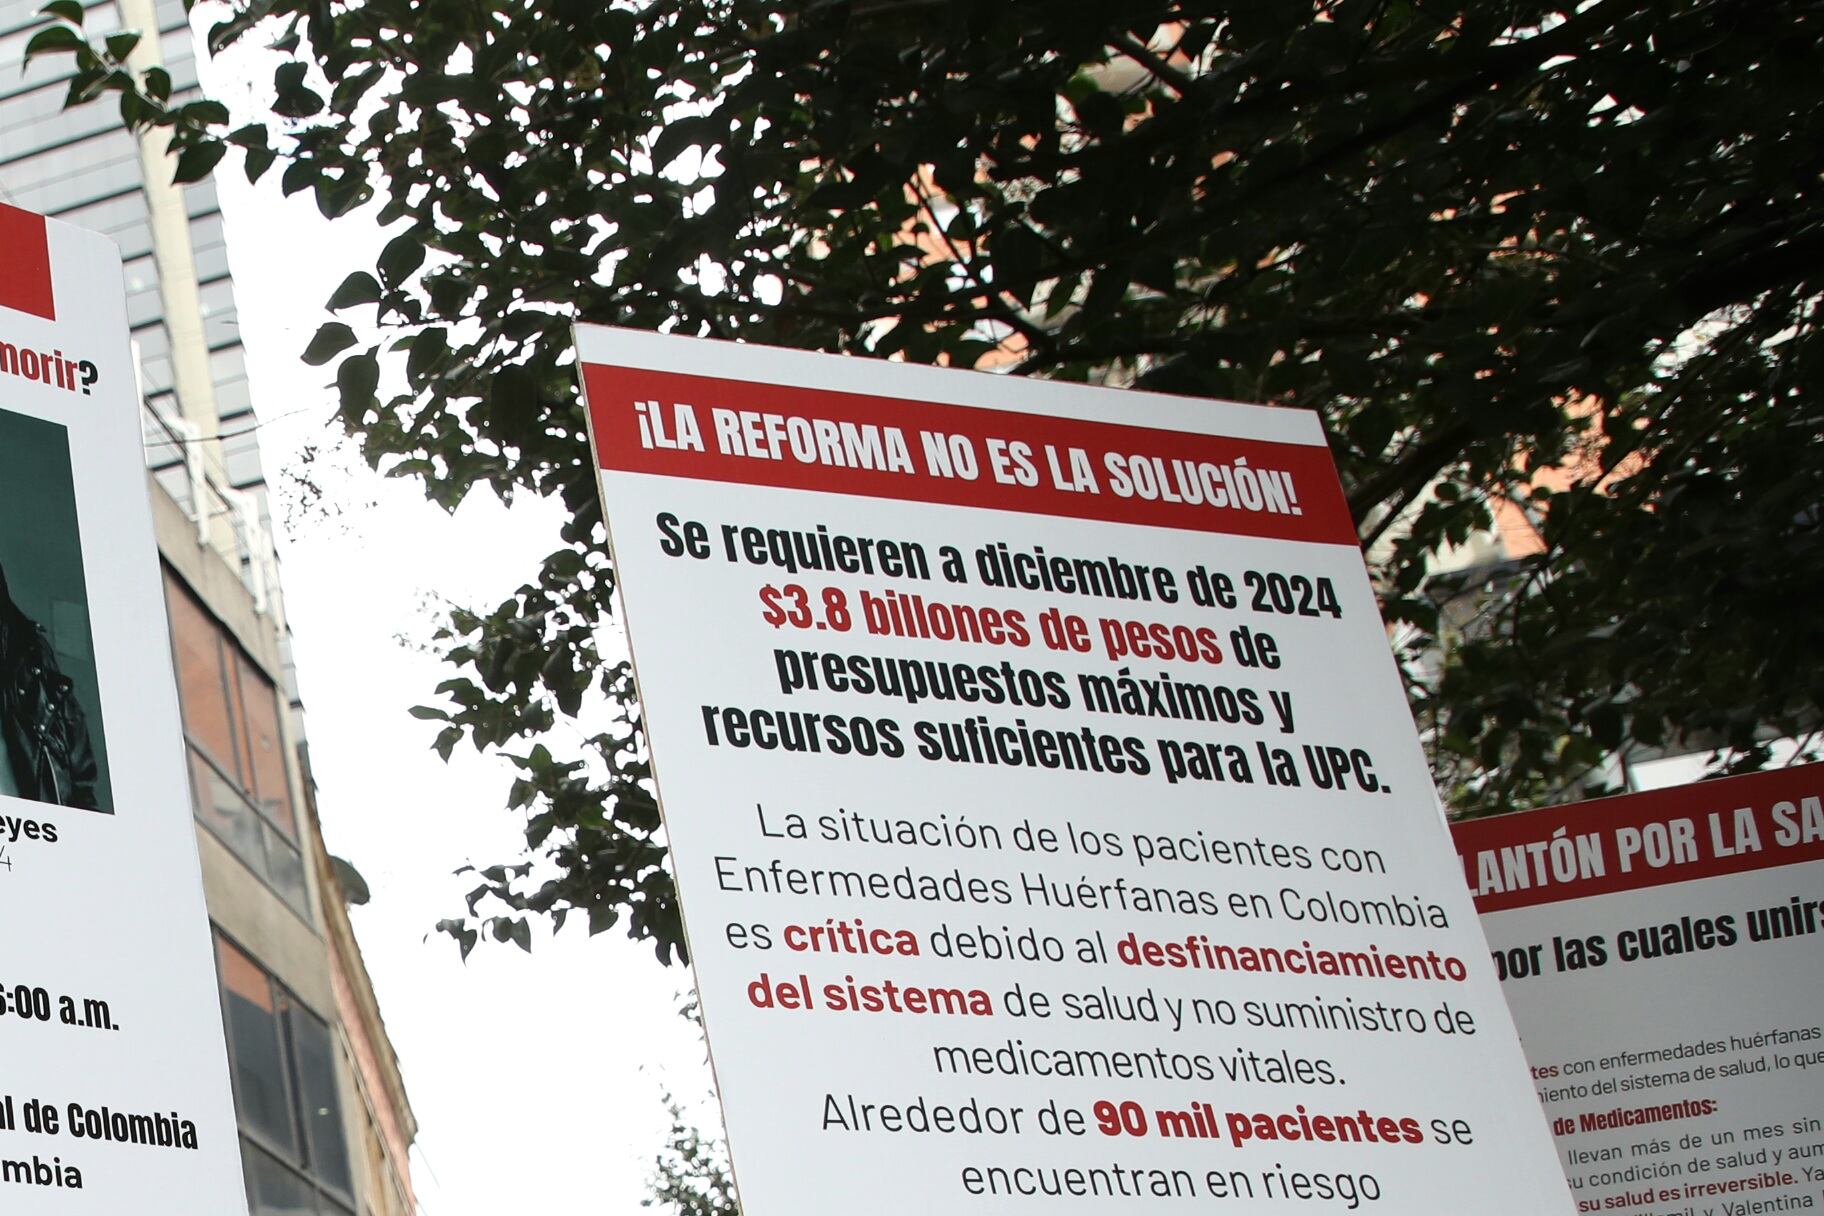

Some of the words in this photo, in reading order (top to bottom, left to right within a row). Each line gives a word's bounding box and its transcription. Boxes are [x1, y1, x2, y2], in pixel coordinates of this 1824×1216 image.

[634, 400, 706, 453] ¡LA
[711, 407, 916, 475] REFORMA
[919, 430, 979, 481] NO
[985, 437, 1039, 487] ES
[1044, 444, 1100, 494] LA
[1103, 451, 1303, 516] SOLUCIÓN!
[656, 511, 711, 560] Se
[720, 524, 931, 581] requieren
[938, 545, 968, 584] a
[975, 541, 1179, 604] diciembre
[1185, 564, 1238, 610] de
[1243, 570, 1343, 620] 2024
[758, 583, 852, 633] $3.8
[859, 589, 1031, 648] billones
[1038, 607, 1092, 653] de
[1098, 617, 1224, 665] pesos
[1229, 624, 1282, 670] de
[773, 648, 1071, 710] presupuestos
[1077, 666, 1265, 726] máximos
[1268, 690, 1295, 734] y
[701, 705, 905, 759] recursos
[913, 715, 1151, 776] suficientes
[1156, 739, 1255, 785] para
[1255, 740, 1302, 788] la
[1301, 744, 1392, 794] UPC.
[756, 803, 808, 839] La
[818, 807, 1002, 850] situación
[1012, 819, 1059, 853] de
[1066, 821, 1124, 857] los
[1132, 830, 1313, 870] pacientes
[1320, 847, 1387, 874] con
[1615, 817, 1699, 873] POR
[1708, 807, 1762, 858] LA
[714, 856, 1013, 905] Enfermedades
[1020, 872, 1219, 916] Huérfanas
[1227, 892, 1273, 919] en
[1279, 887, 1450, 929] Colombia
[725, 922, 773, 950] es
[783, 918, 920, 956] crítica
[930, 923, 1064, 963] debido
[1075, 930, 1108, 964] al
[1116, 932, 1467, 982] desfinanciamiento
[1552, 935, 1608, 973] las
[1616, 914, 1738, 962] cuales
[58, 995, 120, 1031] a.m.
[747, 972, 814, 1010] del
[823, 974, 994, 1016] sistema
[1003, 982, 1051, 1018] de
[1061, 985, 1160, 1022] salud
[1163, 997, 1182, 1033] y
[1191, 998, 1237, 1026] no
[1243, 995, 1427, 1034] suministro
[1433, 1001, 1476, 1036] de
[933, 1039, 1215, 1081] medicamentos
[1218, 1047, 1346, 1085] vitales.
[1562, 1060, 1596, 1076] con
[1599, 1040, 1727, 1071] enfermedades
[1729, 1026, 1822, 1051] huérfanas
[23, 1098, 60, 1136] de
[67, 1102, 199, 1150] Colombia
[822, 1093, 1024, 1135] Alrededor
[1037, 1099, 1086, 1136] de
[1093, 1100, 1148, 1137] 90
[1155, 1101, 1221, 1139] mil
[1224, 1104, 1424, 1148] pacientes
[1430, 1118, 1474, 1146] se
[1553, 1117, 1576, 1137] de
[1578, 1098, 1718, 1133] Medicamentos:
[961, 1163, 1196, 1197] encuentran
[1206, 1170, 1254, 1198] en
[1262, 1162, 1381, 1210] riesgo
[1578, 1199, 1601, 1213] su
[1604, 1187, 1655, 1210] salud
[1658, 1188, 1681, 1202] es
[1683, 1170, 1799, 1199] irreversible.
